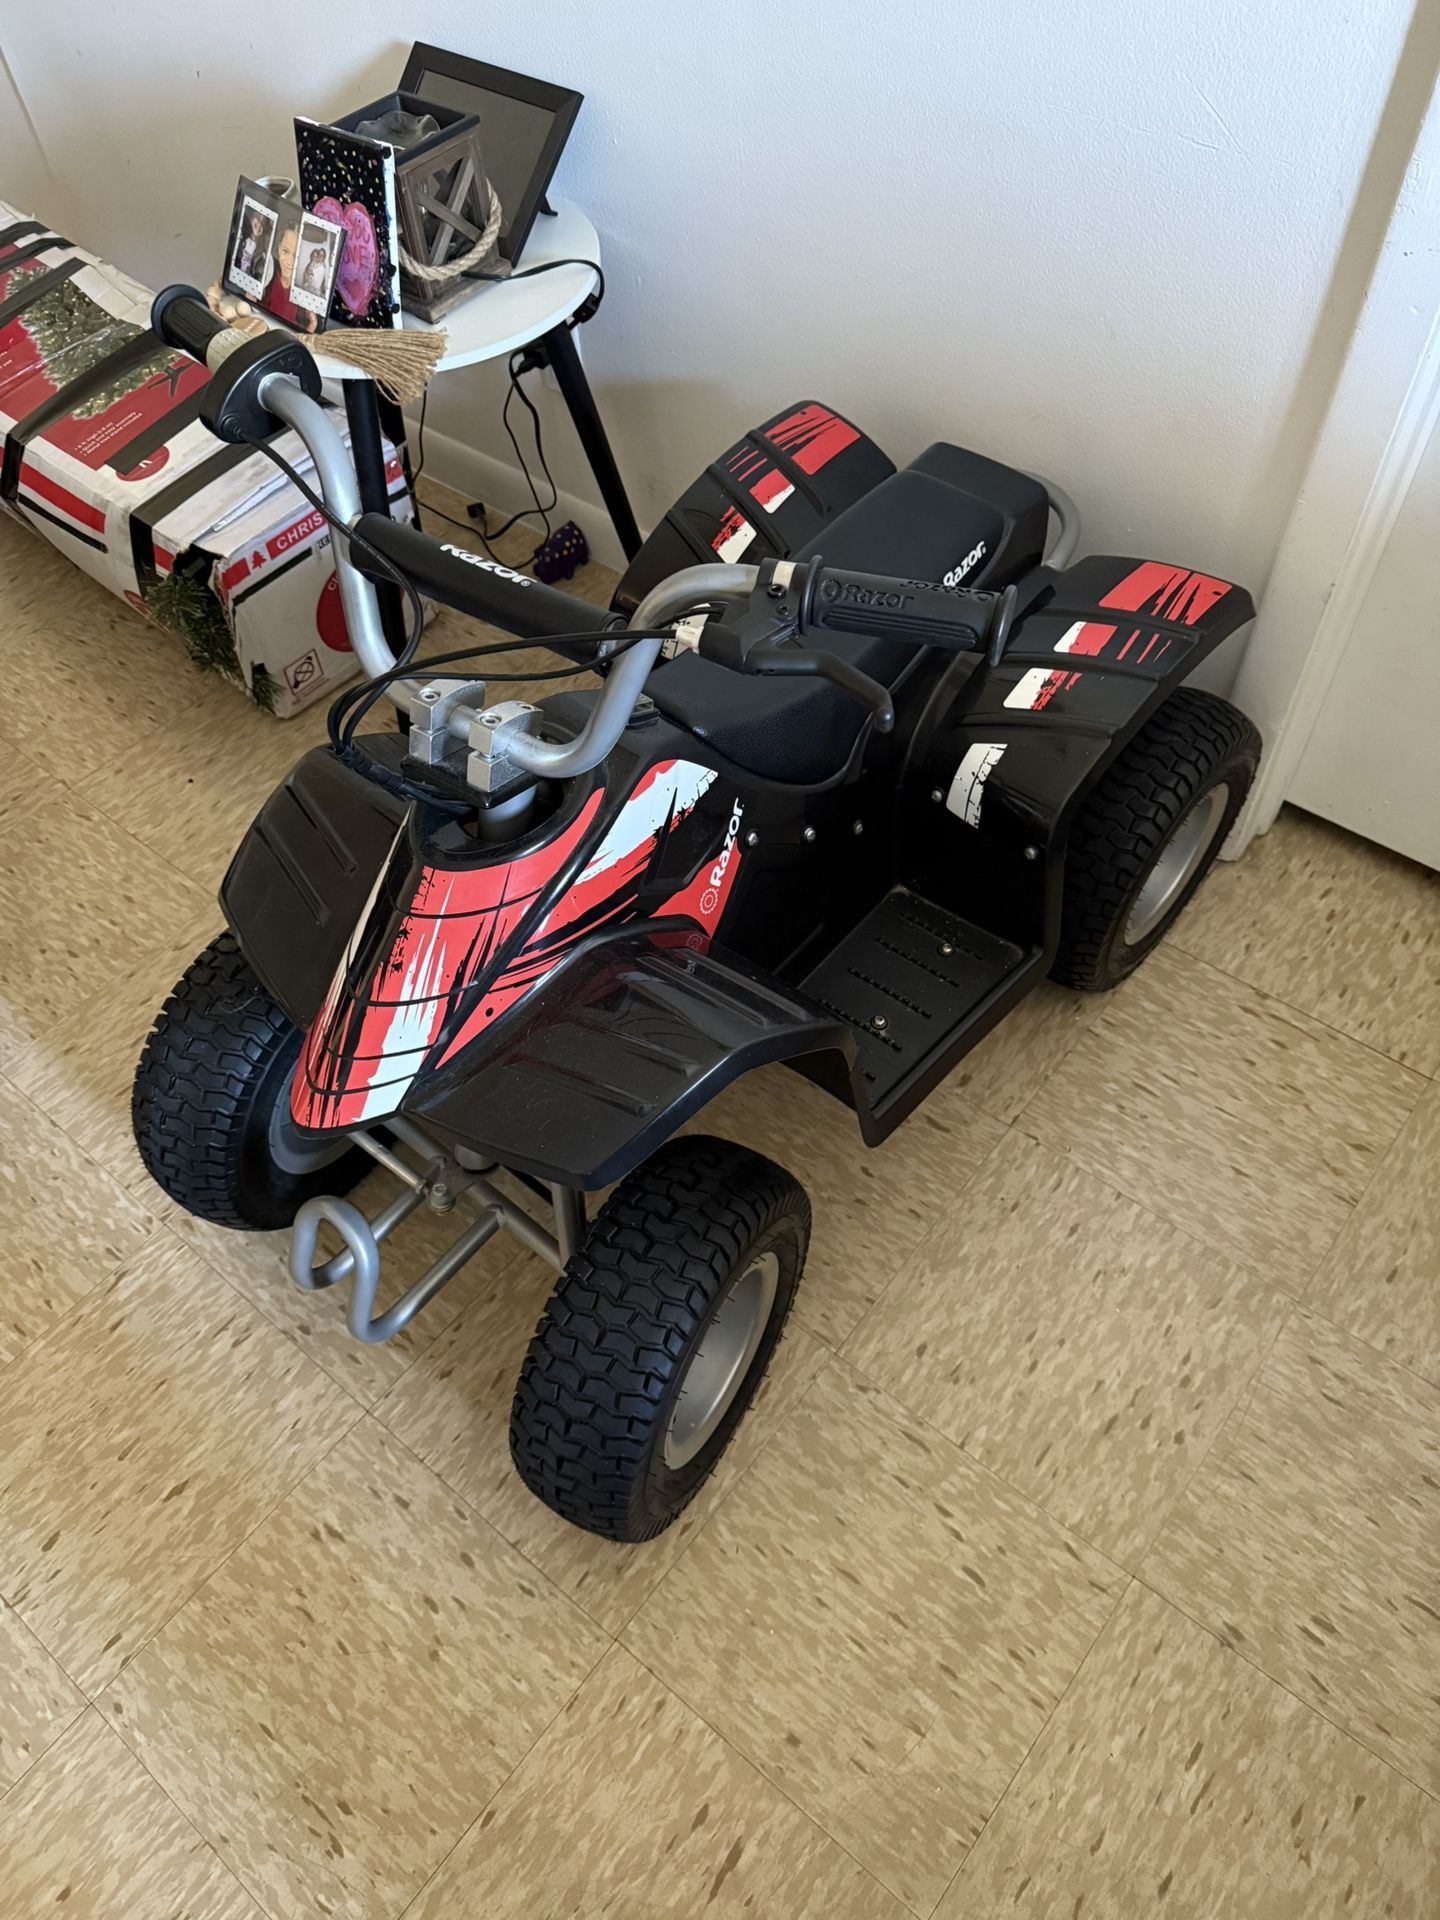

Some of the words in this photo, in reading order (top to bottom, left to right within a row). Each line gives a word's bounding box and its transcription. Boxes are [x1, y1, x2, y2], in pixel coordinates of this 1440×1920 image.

[343, 244, 370, 268] OVE
[276, 512, 324, 550] CHRIS
[842, 583, 915, 609] Razor
[710, 797, 744, 887] Razor
